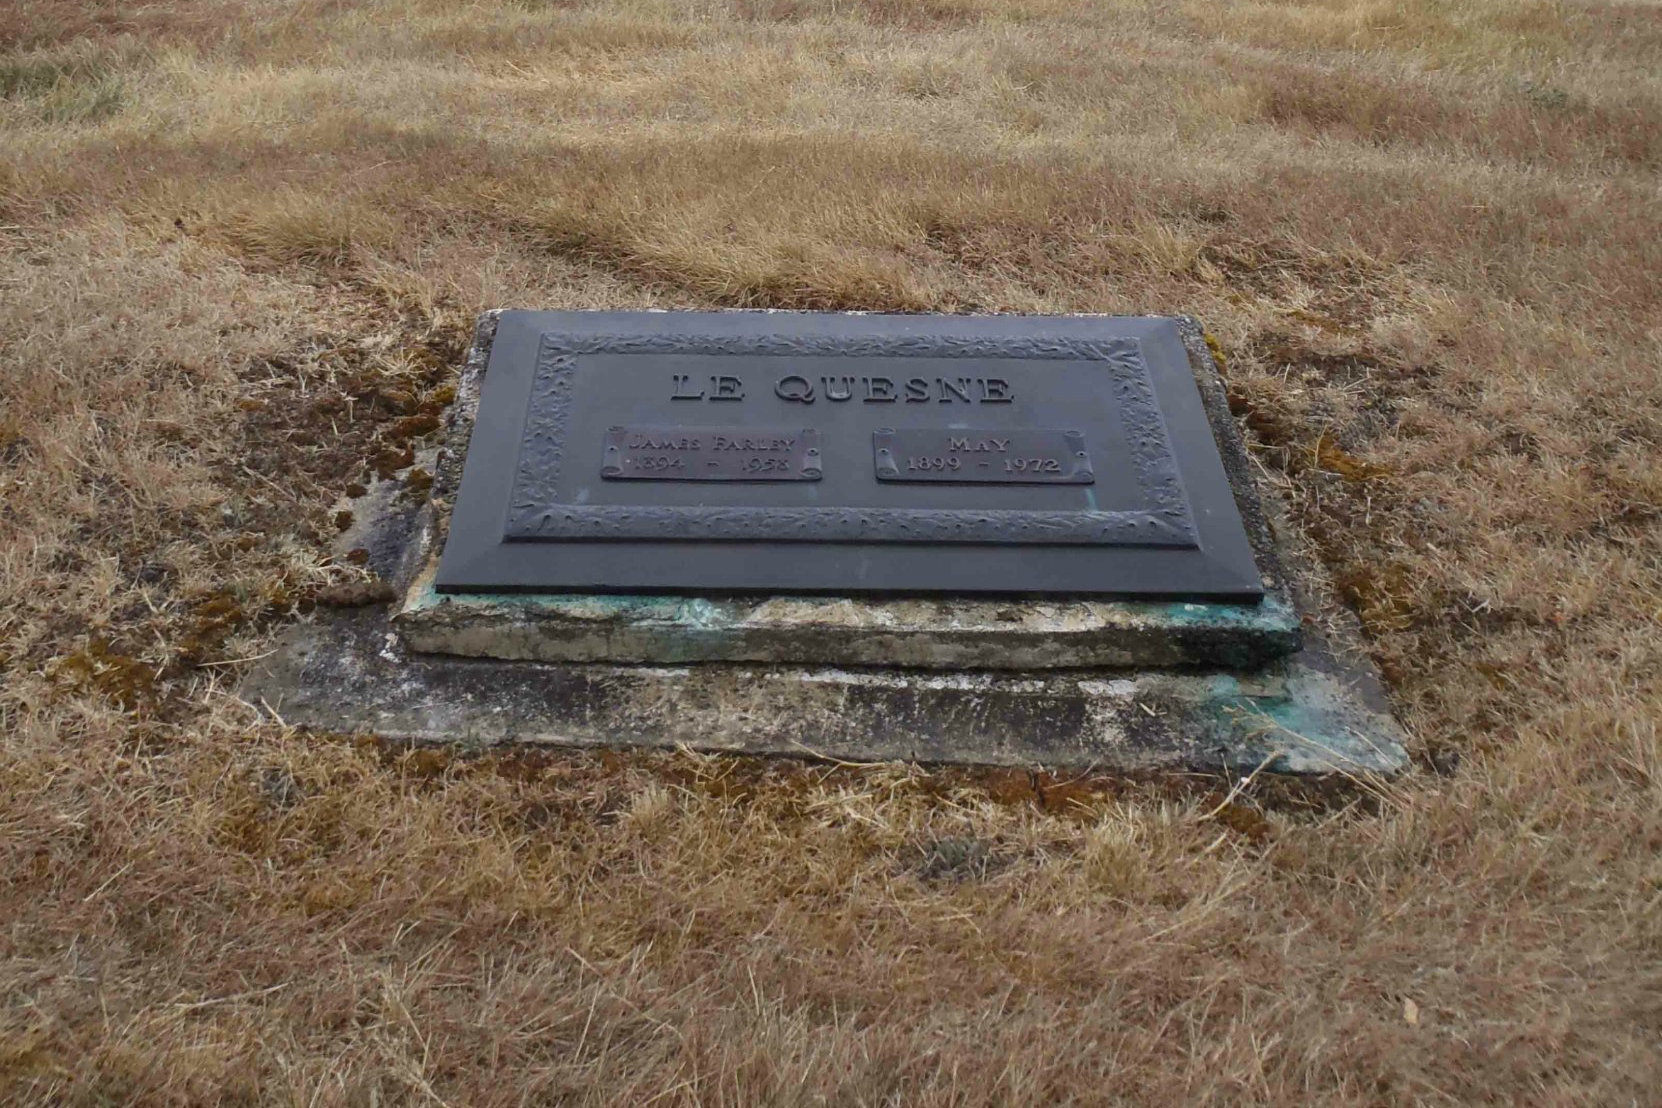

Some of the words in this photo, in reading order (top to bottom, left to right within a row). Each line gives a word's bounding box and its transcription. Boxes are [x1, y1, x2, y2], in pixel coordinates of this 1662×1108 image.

[671, 374, 745, 402] LE
[775, 375, 1014, 404] QUESNE
[629, 434, 701, 450] JAMES
[712, 437, 795, 452] FARLEY
[948, 437, 1010, 452] MAY
[634, 456, 685, 471] 1894
[907, 456, 961, 471] 1899
[1004, 458, 1061, 473] 1972
